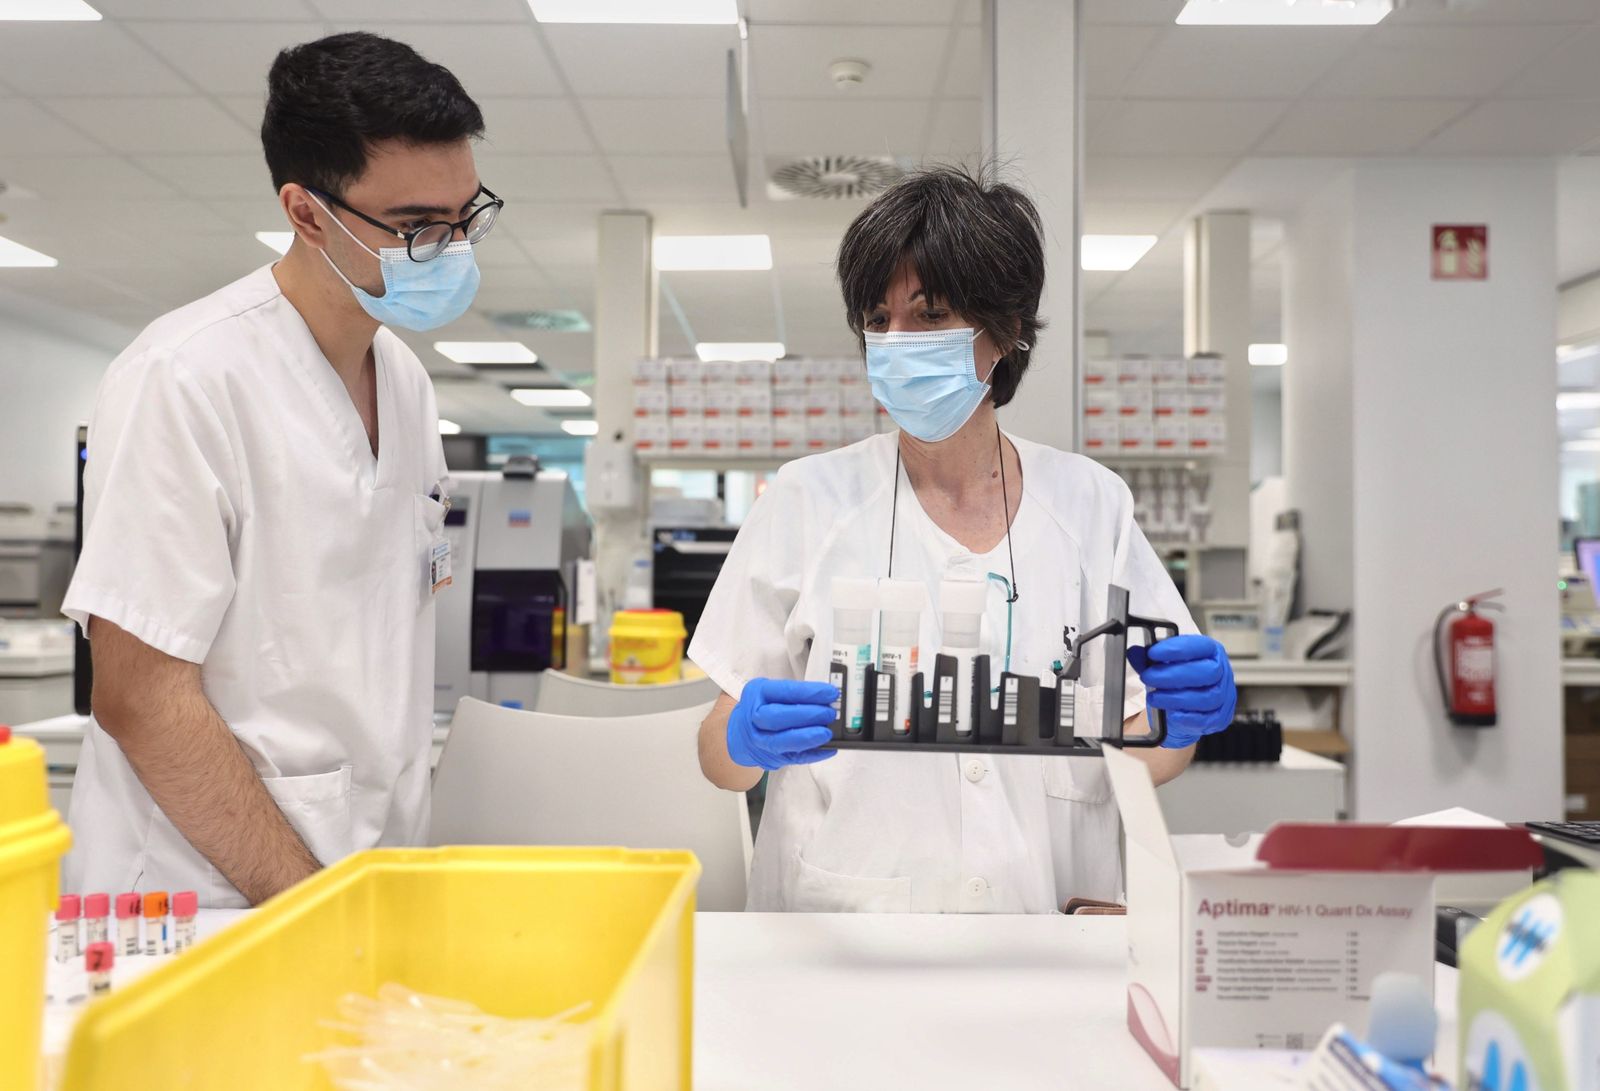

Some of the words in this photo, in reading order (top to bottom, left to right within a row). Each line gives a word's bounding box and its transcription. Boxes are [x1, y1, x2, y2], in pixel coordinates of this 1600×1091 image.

[1278, 904, 1312, 916] HIV-1
[1315, 904, 1352, 916] Quant
[1355, 904, 1373, 916] Dx
[1376, 904, 1413, 919] Assay
